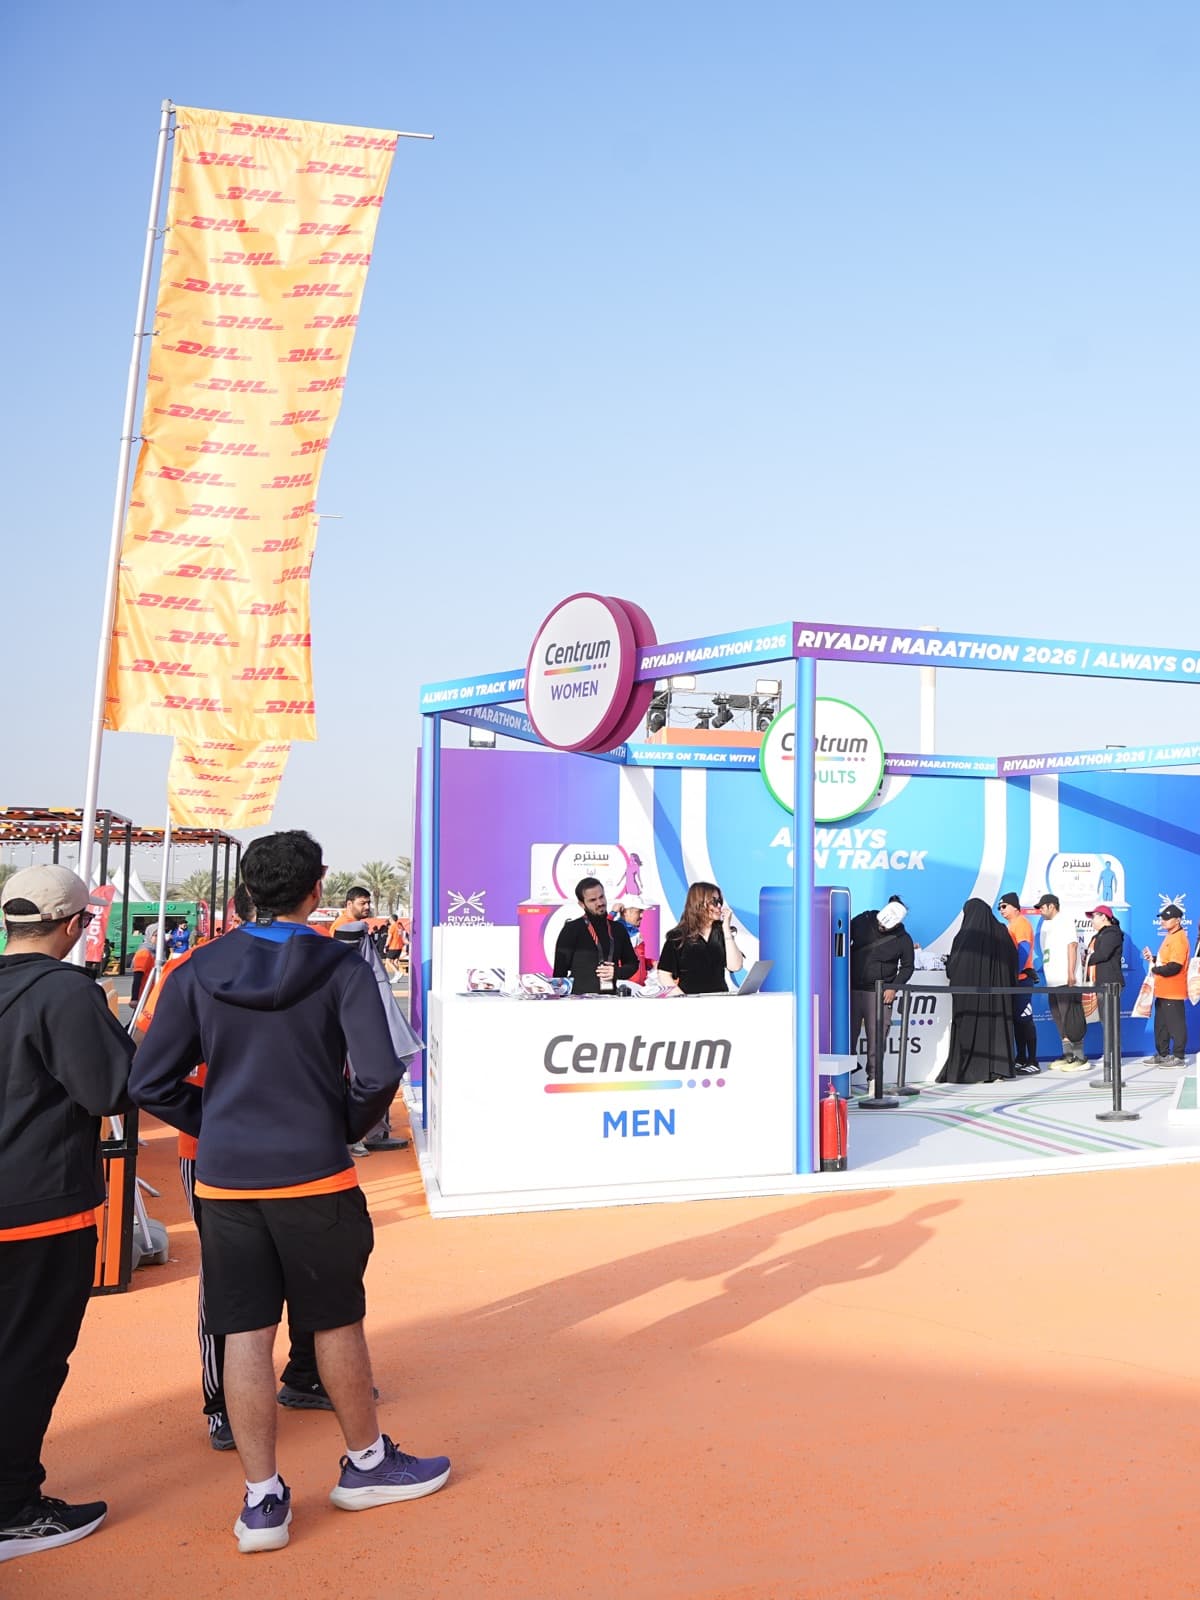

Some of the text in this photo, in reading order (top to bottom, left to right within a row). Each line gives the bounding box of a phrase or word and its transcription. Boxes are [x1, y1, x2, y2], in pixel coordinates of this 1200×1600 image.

[229, 123, 291, 140] DHL
[198, 152, 256, 168] DHL
[306, 161, 368, 178] DHL
[226, 187, 284, 202] DHL
[190, 216, 250, 232] DHL
[298, 223, 352, 235] DHL
[223, 252, 281, 265] DHL
[182, 278, 247, 297] DHL
[292, 284, 344, 297] DHL
[216, 316, 275, 329] DHL
[176, 341, 242, 360] DHL
[288, 348, 335, 362] DHL
[207, 379, 269, 392] DHL
[167, 404, 235, 423] DHL
[281, 410, 322, 425] DHL
[198, 442, 259, 456] DHL
[157, 467, 226, 486] DHL
[271, 474, 313, 488] DHL
[189, 504, 250, 519] DHL
[148, 531, 214, 547] DHL
[262, 537, 300, 552] DHL
[175, 564, 239, 581] DHL
[137, 593, 203, 611] DHL
[250, 601, 288, 616] DHL
[168, 630, 233, 646] DHL
[544, 639, 611, 666] Centrum
[641, 634, 787, 670] RIYADH MARATHON 2026
[798, 630, 888, 653] RIYADH
[890, 637, 1020, 661] MARATHON
[1022, 647, 1077, 665] 2026
[1093, 651, 1176, 672] ALWAYS
[132, 660, 196, 677] DHL
[240, 668, 289, 680] DHL
[422, 687, 458, 704] ALWAYS
[460, 687, 474, 699] ON
[475, 682, 506, 696] TRACK
[551, 680, 599, 701] WOMEN
[164, 696, 222, 711] DHL
[473, 706, 522, 730] MARATHON
[781, 733, 869, 753] Ctrum
[632, 752, 756, 762] ALWAYS ON TRACK WITH
[885, 758, 918, 768] RIYADH
[919, 760, 972, 769] MARATHON
[1002, 758, 1046, 772] RIYADH
[1047, 753, 1112, 769] MARATHON
[1115, 751, 1146, 763] 2026
[769, 827, 888, 849] AWAYS
[573, 851, 609, 862] سنترم
[836, 850, 928, 870] TRACK
[543, 1034, 732, 1074] Centrum
[602, 1108, 676, 1138] MEN
